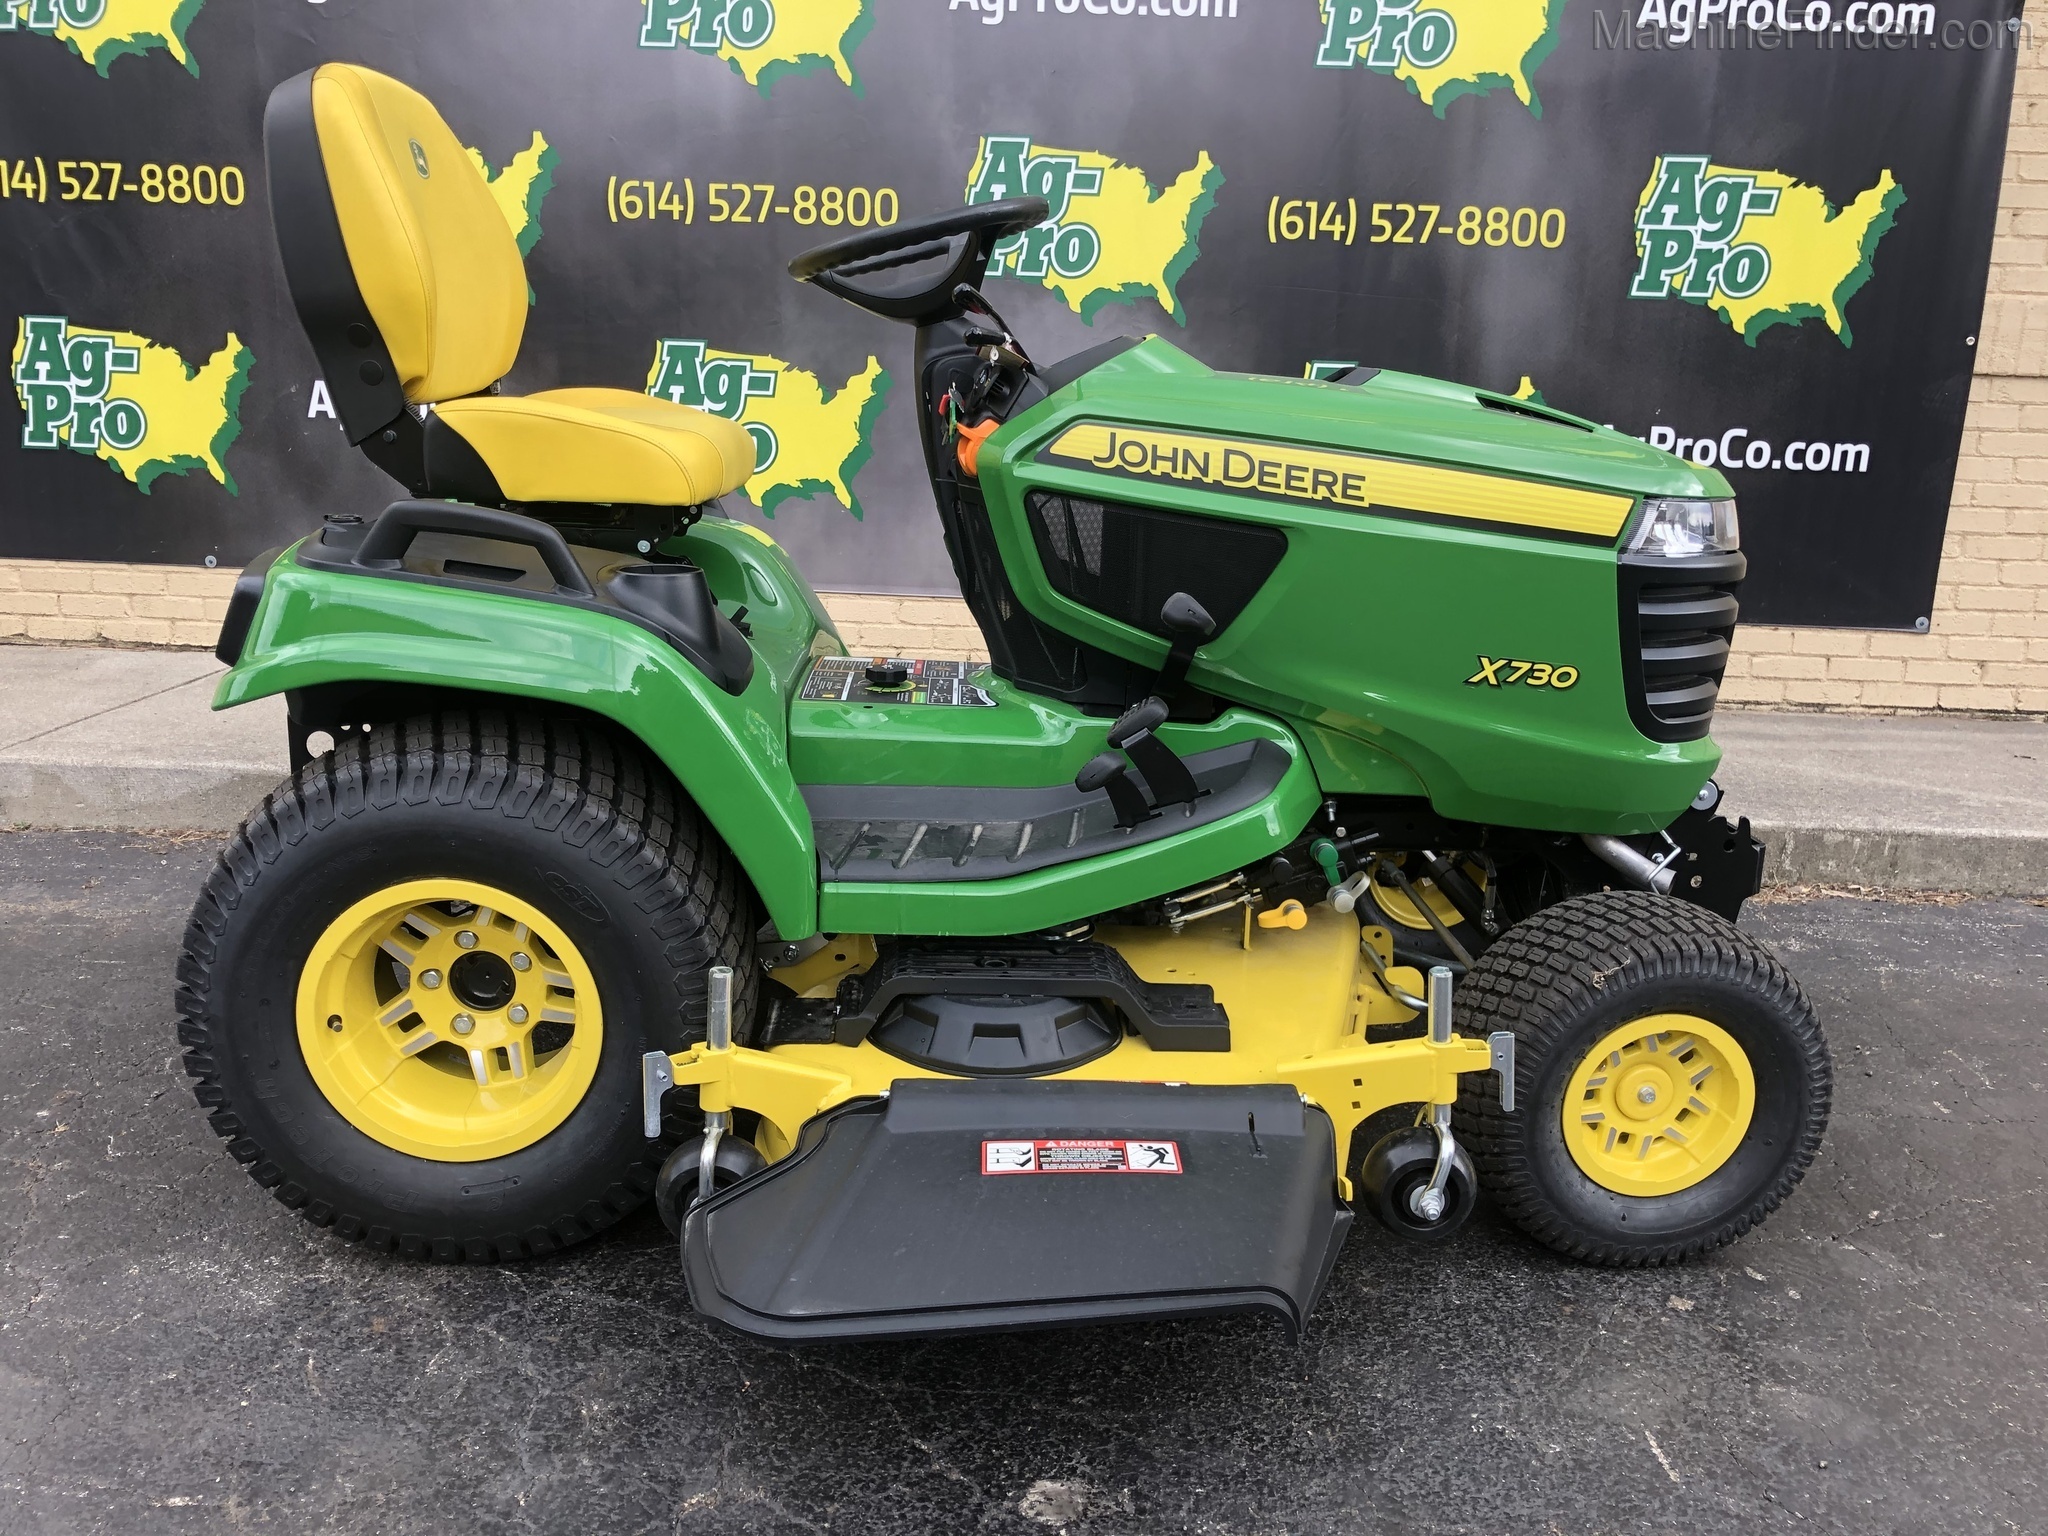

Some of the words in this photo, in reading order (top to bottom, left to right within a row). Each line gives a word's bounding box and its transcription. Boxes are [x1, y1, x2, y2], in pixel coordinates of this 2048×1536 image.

[639, 0, 773, 48] Pro
[1315, 0, 1458, 67] Pro
[1636, 0, 1936, 43] AgProCo.com
[58, 161, 245, 206] 527-8800
[607, 176, 694, 225] (614)
[708, 183, 898, 227] 527-8800
[1637, 157, 1780, 245] Ag-
[1268, 196, 1357, 245] (614)
[1370, 203, 1566, 248] 527-8800
[1630, 229, 1770, 298] Pro
[16, 317, 139, 400] Ag-
[651, 341, 776, 421] Ag-
[24, 383, 146, 449] Pro
[1093, 431, 1209, 478] JOHN
[1222, 448, 1366, 502] DEERE
[1603, 424, 1871, 472] ProCo.com
[1463, 655, 1579, 689] X730
[1060, 1140, 1115, 1148] DANGER
